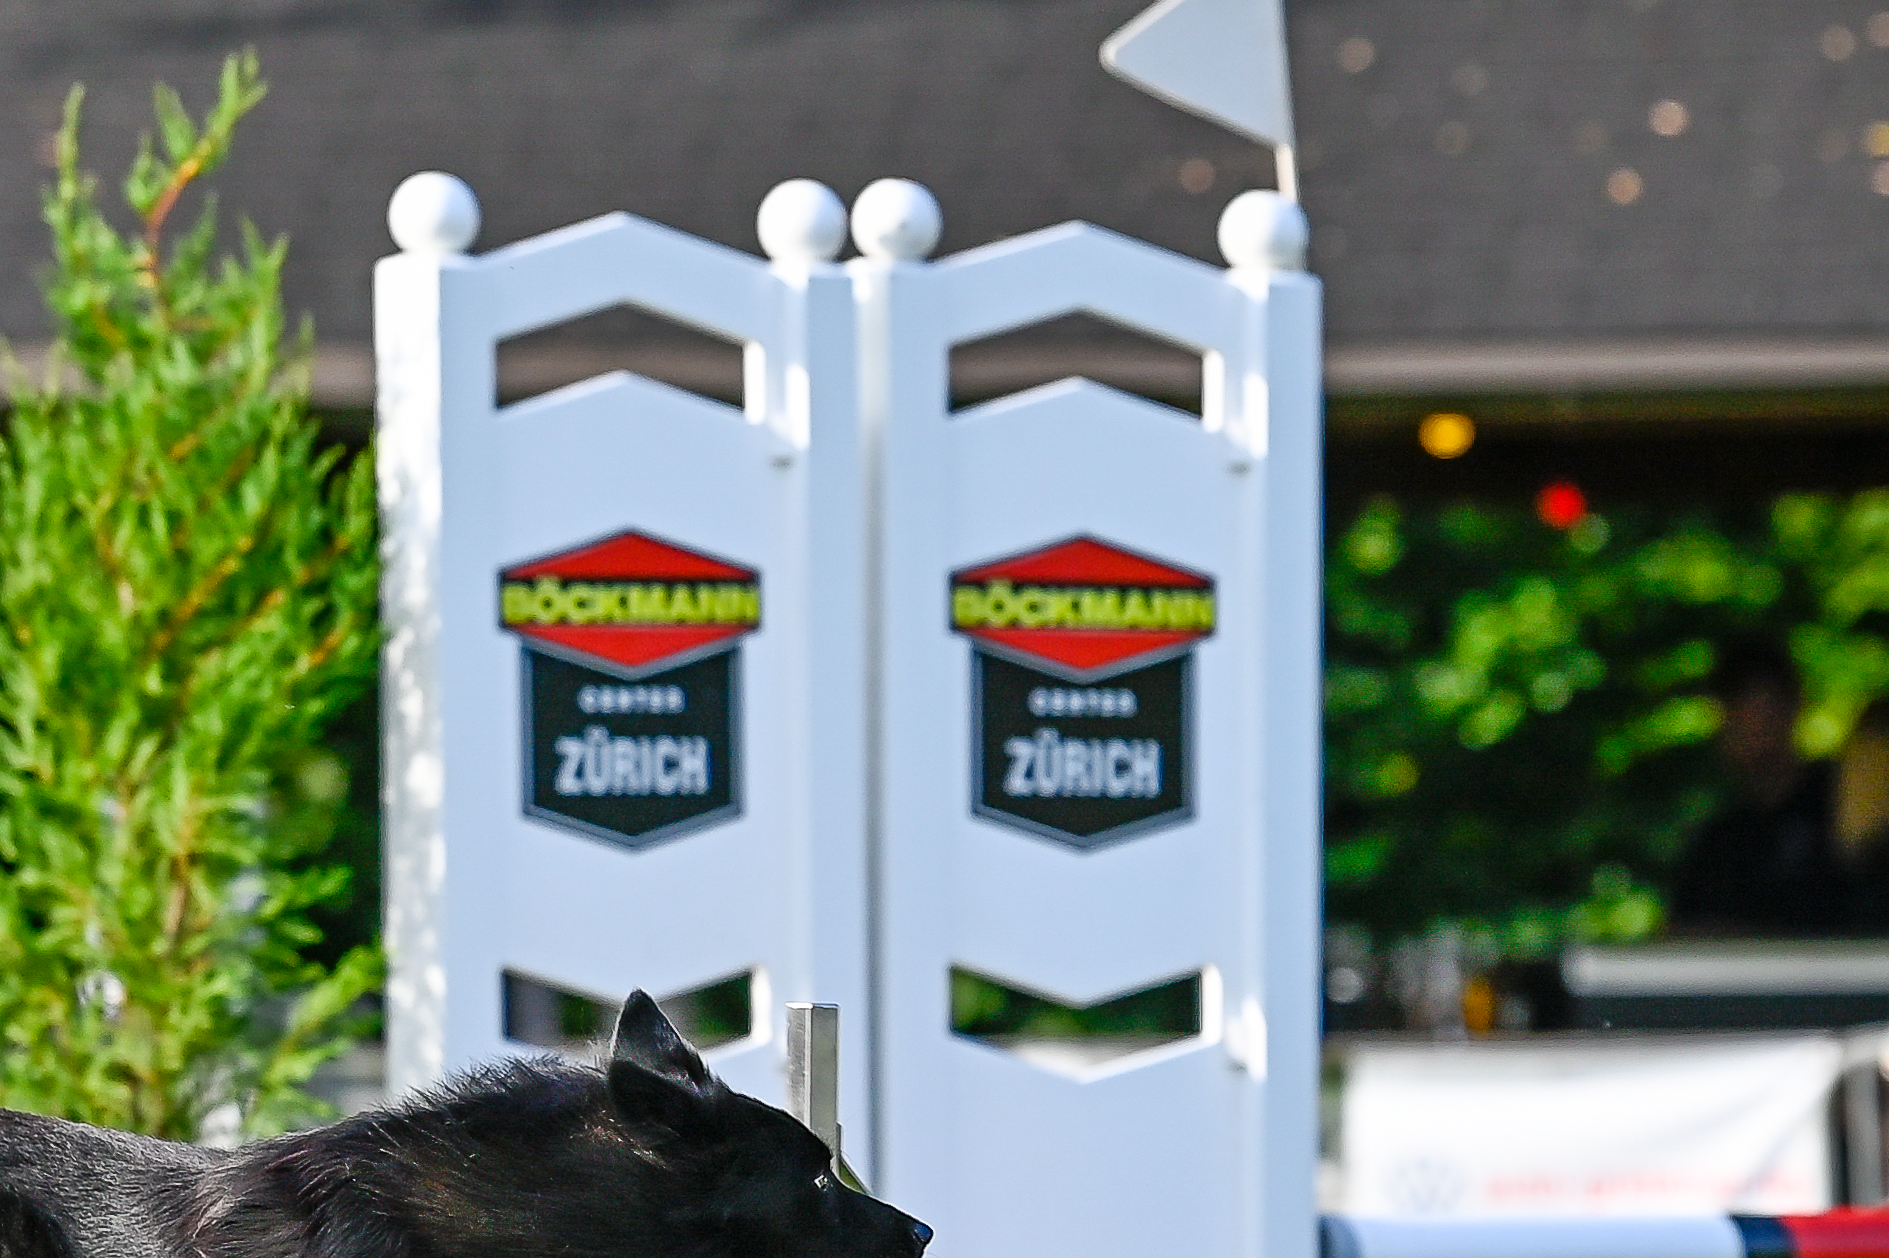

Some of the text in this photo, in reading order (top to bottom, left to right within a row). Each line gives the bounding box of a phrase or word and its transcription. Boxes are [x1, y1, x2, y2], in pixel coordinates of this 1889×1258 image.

[503, 576, 761, 626] BÖCKMANN
[954, 580, 1215, 631] BÖCKMANN
[554, 724, 710, 797] ZÜRICH
[1004, 727, 1162, 798] ZÜRICH
